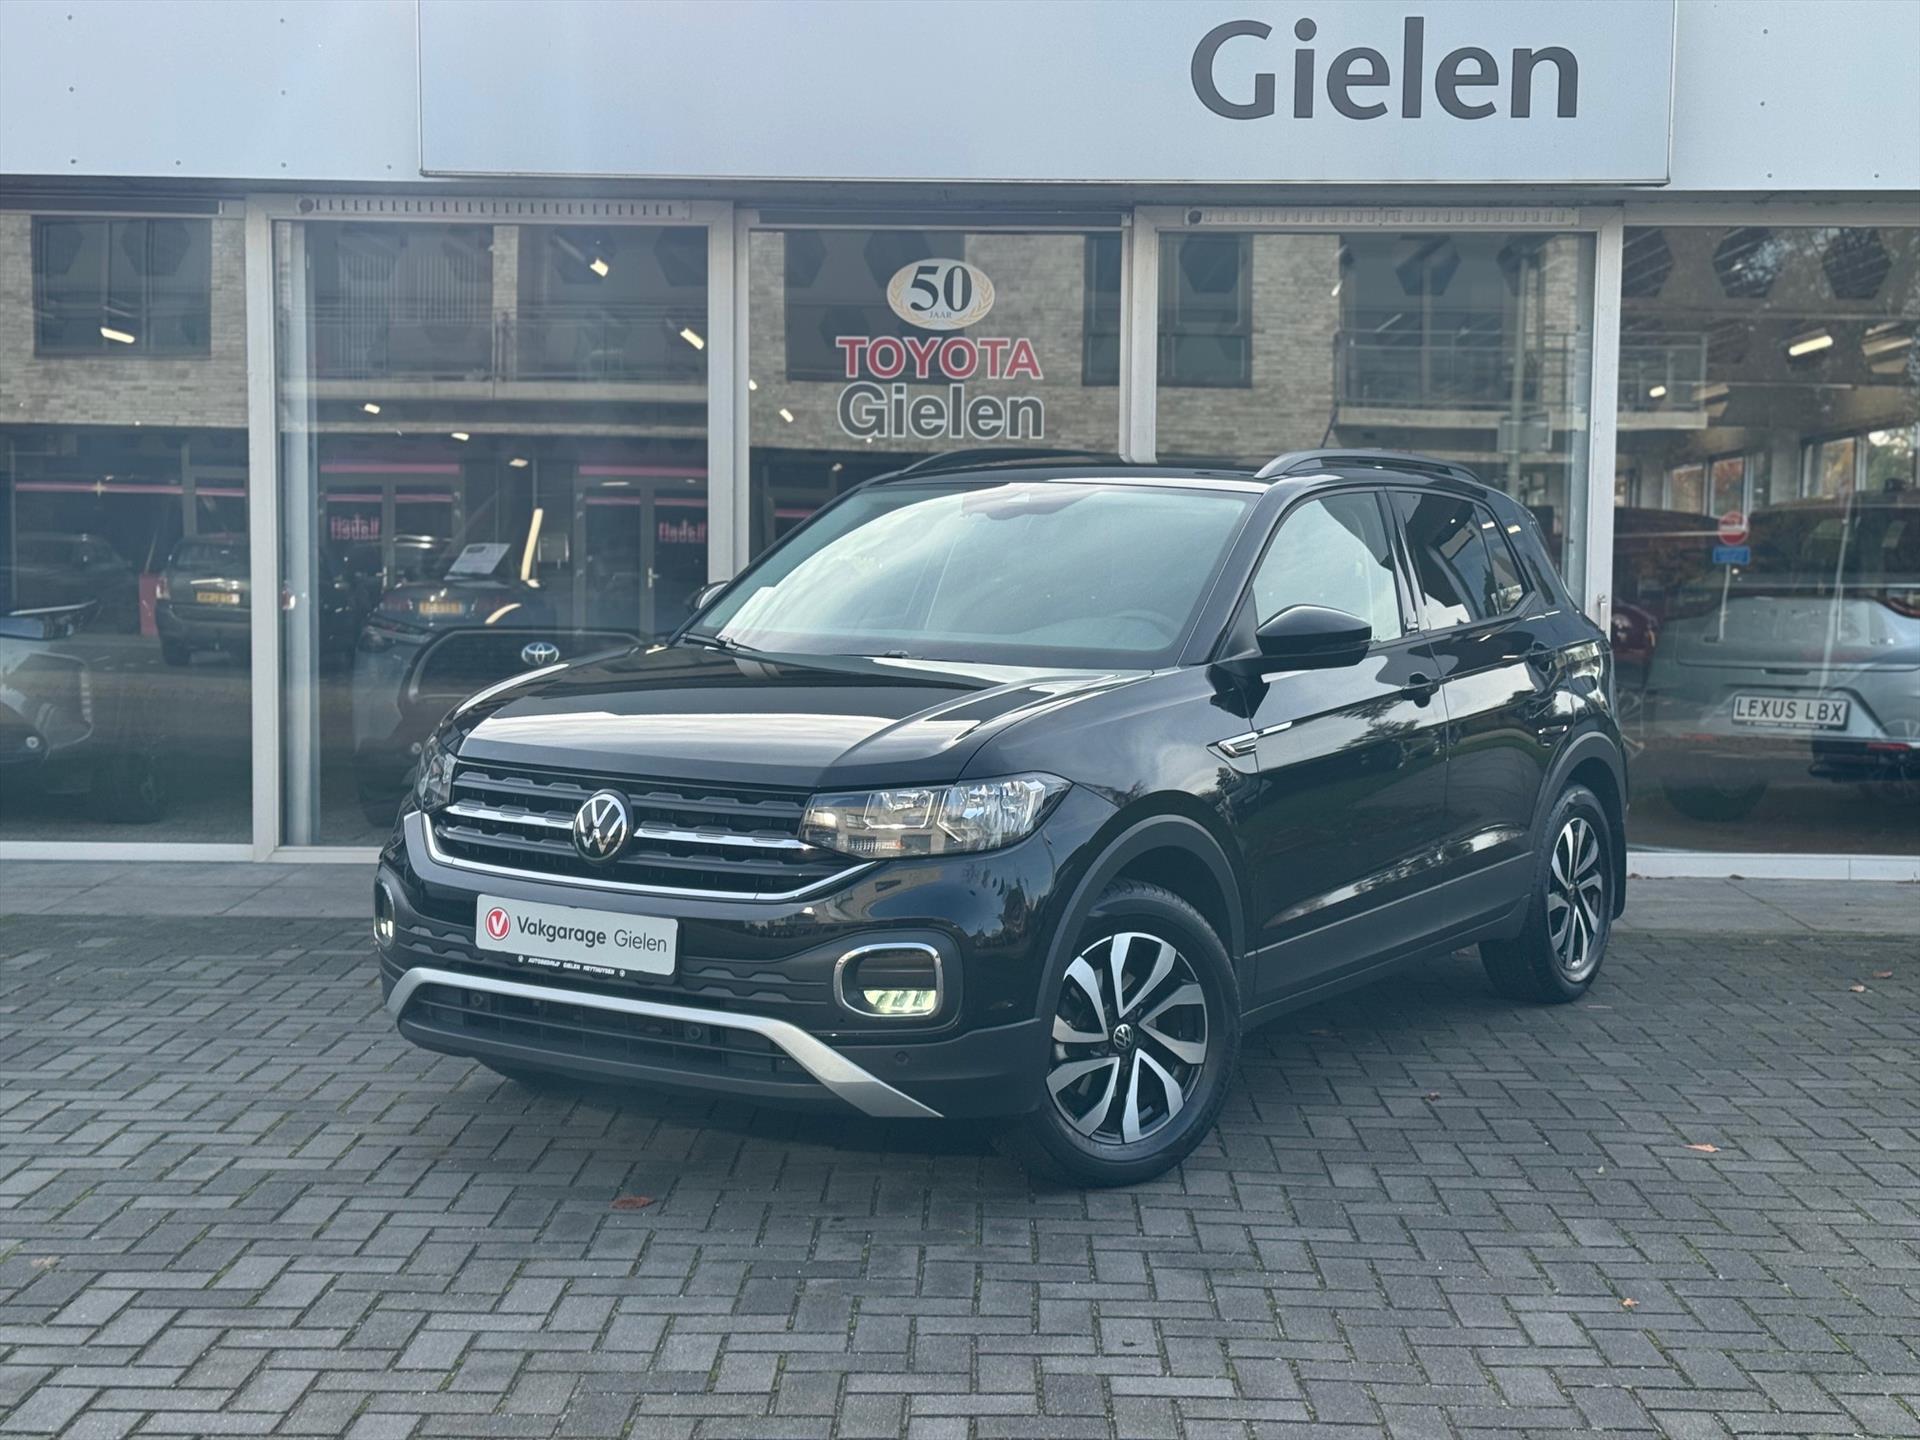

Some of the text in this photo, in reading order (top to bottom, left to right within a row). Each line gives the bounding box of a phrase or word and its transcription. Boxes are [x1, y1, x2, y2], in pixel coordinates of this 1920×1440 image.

[1191, 16, 1579, 120] Gielen
[910, 265, 972, 312] 50
[929, 311, 952, 319] JAAR
[836, 336, 1044, 380] TOYOTA
[837, 381, 1045, 439] Gielen
[1736, 699, 1844, 721] LEXUS LBX
[516, 915, 607, 948] Vakgarage
[614, 929, 667, 952] Gielen
